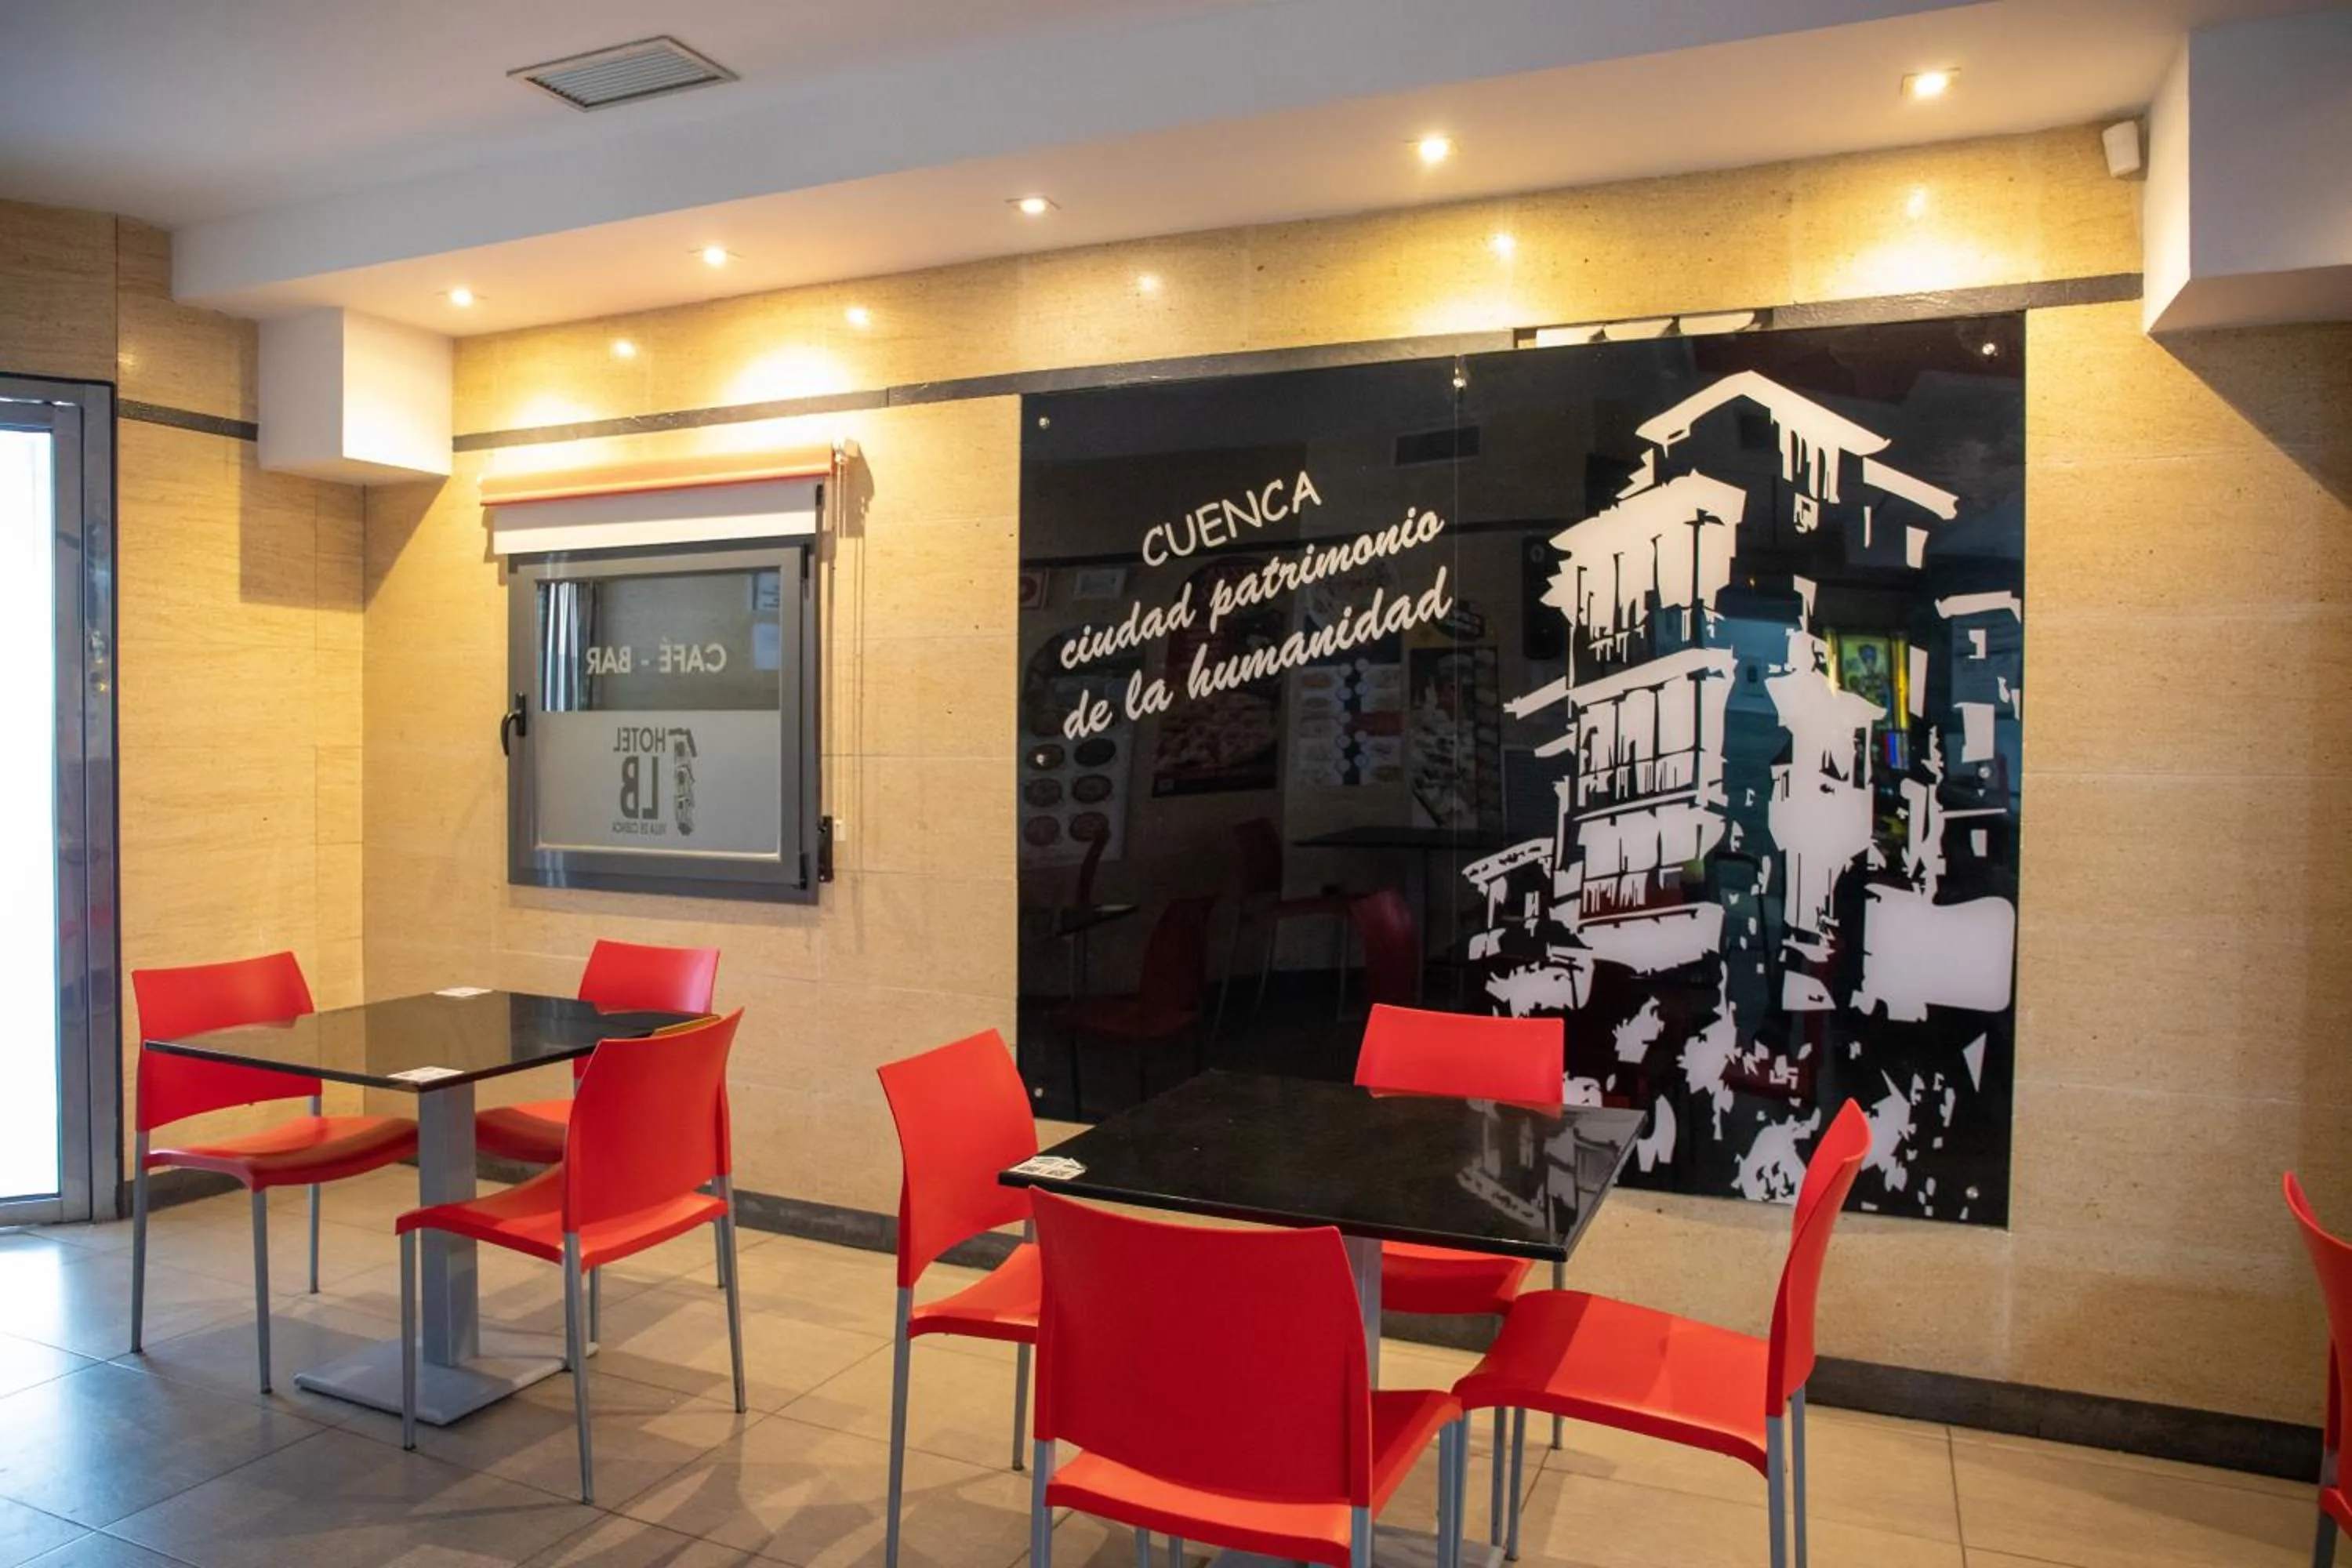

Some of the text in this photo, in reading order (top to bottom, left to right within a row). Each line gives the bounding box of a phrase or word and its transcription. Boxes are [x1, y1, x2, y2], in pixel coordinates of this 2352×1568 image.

[1060, 506, 1446, 670] ciudad patrimonio
[1142, 470, 1323, 567] CUENCA
[1062, 564, 1454, 741] de la humanidad
